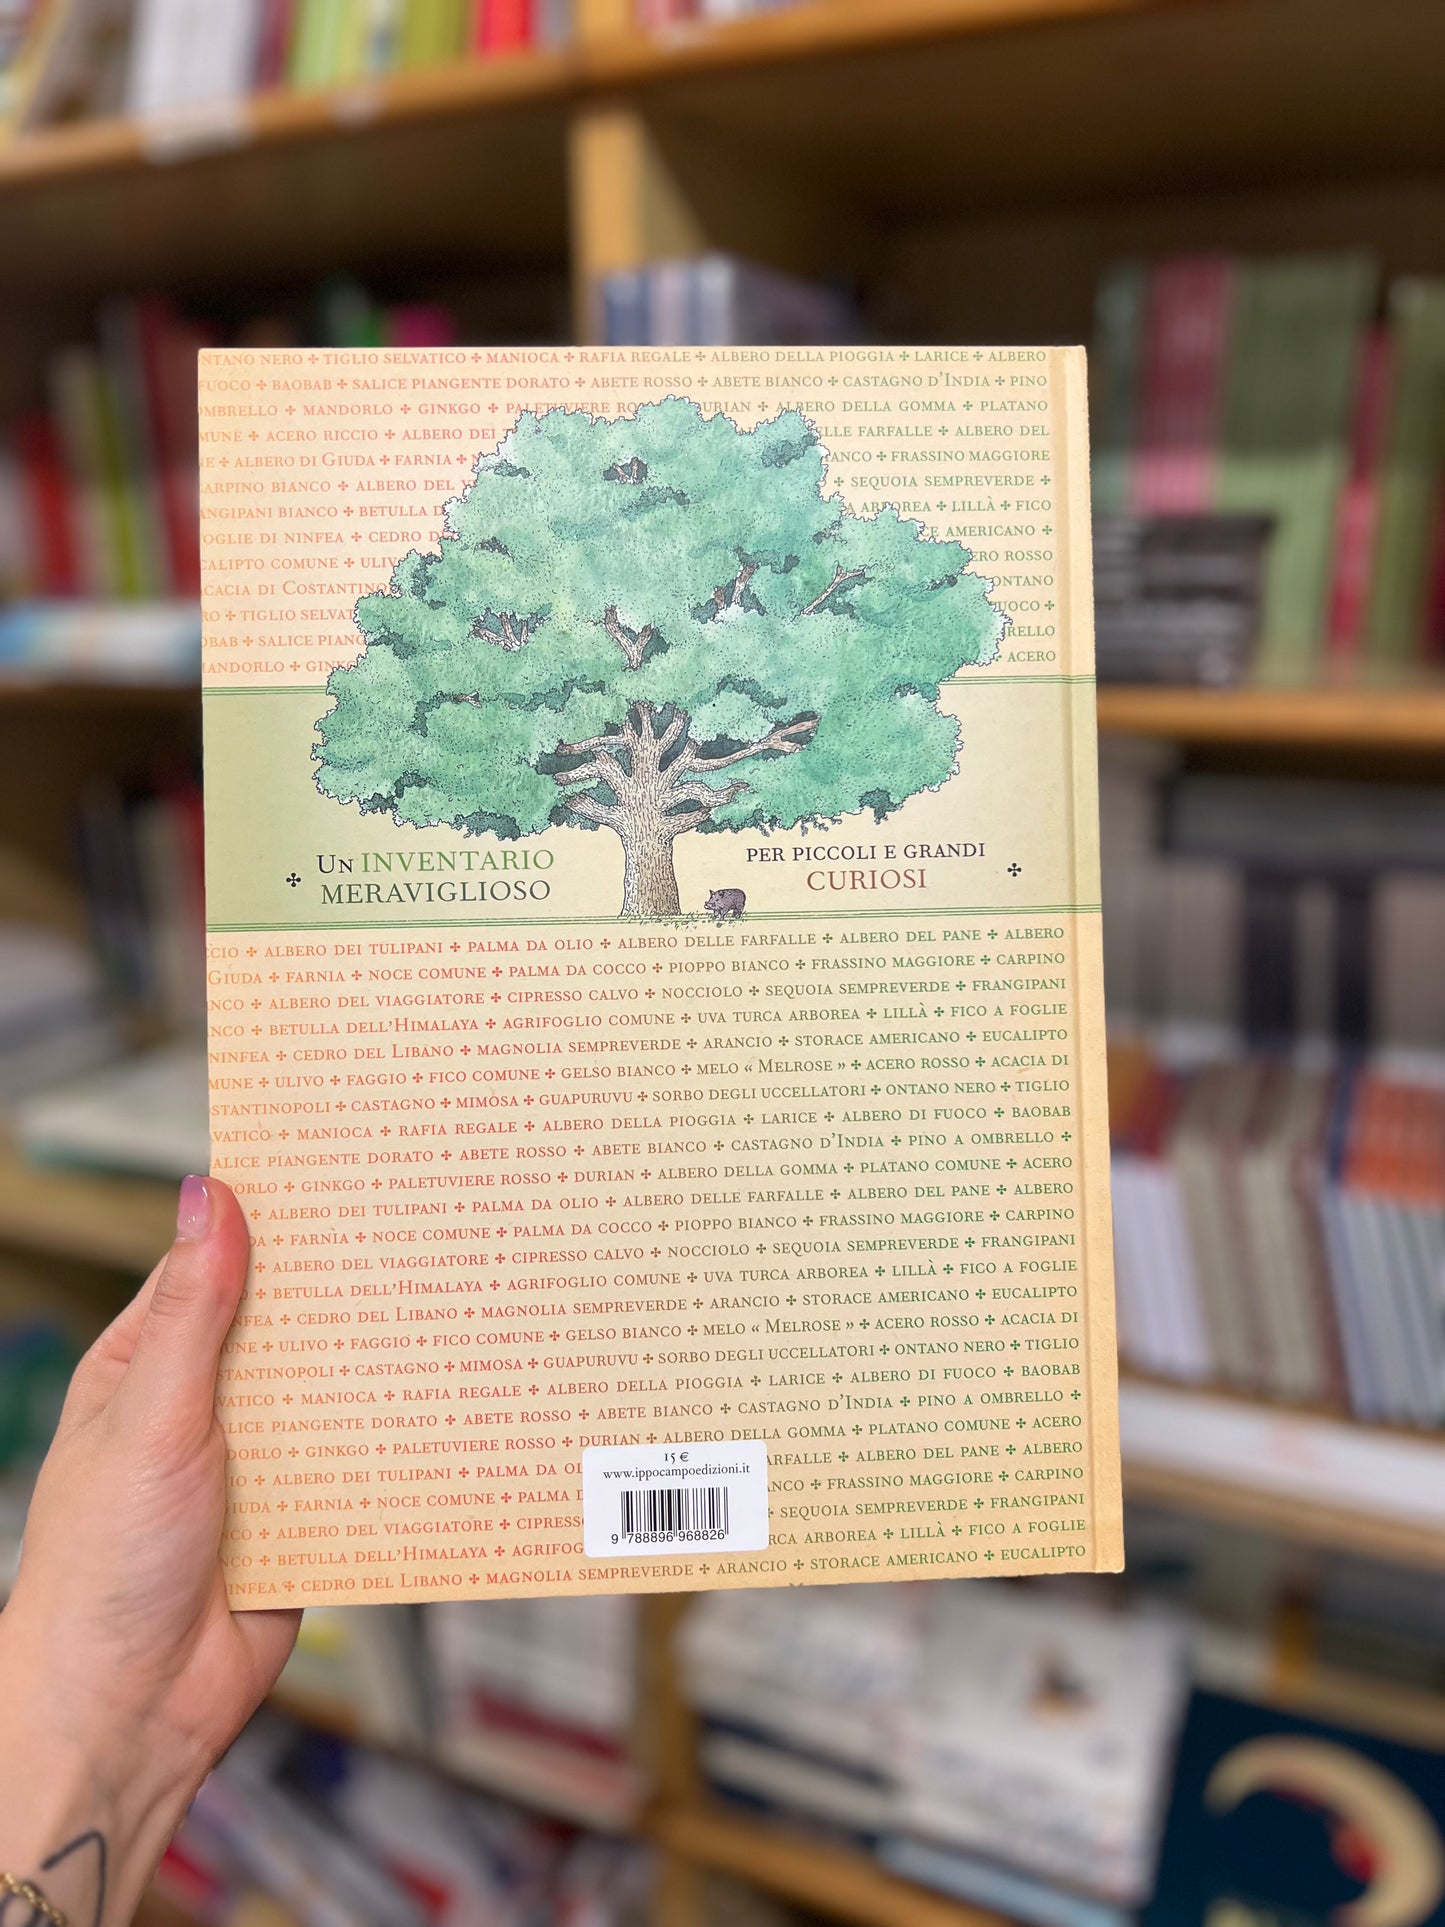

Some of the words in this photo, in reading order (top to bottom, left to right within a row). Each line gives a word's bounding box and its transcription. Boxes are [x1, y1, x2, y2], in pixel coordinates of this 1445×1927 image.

[258, 353, 303, 366] NERO
[322, 352, 379, 365] TIGLIO
[383, 352, 467, 365] SELVATICO
[486, 351, 560, 364] MANIOCA
[579, 351, 627, 363] RAFIA
[631, 351, 692, 363] REGALE
[710, 350, 770, 363] ALBERO
[775, 350, 825, 362] DELLA
[829, 350, 895, 362] PIOGGIA
[914, 350, 969, 362] LARICE
[988, 350, 1047, 362] ALBERO
[272, 379, 332, 391] BAOBAB
[352, 378, 407, 390] SALICE
[411, 377, 502, 390] PIANGENTE
[506, 377, 570, 389] DORATO
[590, 376, 639, 388] ABETE
[643, 376, 693, 388] ROSSO
[712, 376, 761, 388] ABETE
[765, 376, 823, 387] BIANCO
[842, 375, 923, 387] CASTAGNO
[1010, 375, 1047, 387] PINO
[303, 403, 393, 416] MANDORLO
[418, 403, 481, 415] GINKGO
[842, 400, 892, 412] DELLA
[898, 400, 956, 412] GOMMA
[980, 400, 1048, 412] PLATANO
[234, 456, 295, 468] ALBERO
[299, 455, 317, 467] DI
[394, 454, 453, 466] FARNIA
[891, 450, 965, 462] FRASSINO
[968, 449, 1051, 462] MAGGIORE
[271, 480, 331, 493] BIANCO
[355, 480, 417, 492] ALBERO
[423, 479, 455, 491] DEL
[850, 476, 918, 491] SEQUOIA
[924, 475, 1035, 487] SEMPREVERDE
[951, 495, 996, 512] LILLÀ
[1015, 499, 1052, 511] FICO
[259, 532, 277, 544] DI
[284, 532, 344, 544] NINFEA
[368, 530, 422, 543] CEDRO
[945, 525, 1036, 537] AMERICANO
[239, 609, 296, 622] TIGLIO
[1007, 650, 1056, 663] ACERO
[361, 849, 554, 873] INVENTARIO
[746, 848, 785, 862] PER
[792, 845, 876, 861] PICCOLI
[884, 845, 896, 859] E
[904, 843, 985, 858] GRANDI
[807, 868, 927, 891] CURIOSI
[321, 879, 551, 905] MERAVIGLIOSO
[264, 944, 327, 958] ALBERO
[334, 944, 362, 956] DEI
[368, 942, 443, 955] TULIPANI
[468, 940, 520, 953] PALMA
[526, 940, 548, 952] DA
[554, 938, 593, 951] OLIO
[617, 936, 678, 949] ALBERO
[684, 935, 735, 948] DELLE
[740, 933, 817, 946] FARFALLE
[839, 931, 899, 944] ALBERO
[905, 930, 937, 943] DEL
[942, 929, 982, 942] PANE
[1004, 927, 1065, 940] ALBERO
[268, 996, 331, 1010] ALBERO
[337, 996, 370, 1008] DEL
[375, 992, 485, 1007] VIAGGIATORE
[507, 990, 583, 1003] CIPRESSO
[588, 988, 639, 1001] CALVO
[661, 986, 743, 999] NOCCIOLO
[765, 984, 833, 1000] SEQUOIA
[839, 981, 950, 995] SEMPREVERDE
[972, 978, 1066, 991] FRANGIPANI
[209, 1051, 270, 1064] NINFEA
[293, 1048, 347, 1062] CEDRO
[353, 1047, 386, 1060] DEL
[477, 1042, 563, 1056] MAGNOLIA
[568, 1038, 681, 1053] SEMPREVERDE
[703, 1036, 773, 1049] ARANCIO
[794, 1033, 864, 1047] STORACE
[869, 1031, 960, 1045] AMERICANO
[982, 1028, 1068, 1042] EUCALIPTO
[297, 1126, 373, 1140] MANIOCA
[398, 1124, 448, 1137] RAFIA
[455, 1121, 518, 1135] REGALE
[542, 1118, 604, 1132] ALBERO
[611, 1116, 663, 1130] DELLA
[669, 1114, 737, 1128] PIOGGIA
[761, 1111, 817, 1125] LARICE
[842, 1109, 902, 1122] ALBERO
[909, 1109, 927, 1121] DI
[933, 1107, 987, 1120] FUOCO
[1011, 1105, 1071, 1118] BAOBAB
[273, 1286, 344, 1300] BETULLA
[506, 1275, 607, 1291] AGRIFOGLIO
[613, 1272, 681, 1286] COMUNE
[703, 1271, 734, 1283] UVA
[739, 1269, 790, 1282] TURCA
[796, 1266, 869, 1280] ARBOREA
[892, 1260, 937, 1277] LILLÀ
[960, 1262, 997, 1275] FICO
[1003, 1262, 1014, 1274] A
[1019, 1259, 1077, 1273] FOGLIE
[354, 1361, 439, 1376] CASTAGNO
[460, 1358, 523, 1372] MIMOSA
[543, 1354, 638, 1369] GUAPURUVU
[658, 1350, 710, 1364] SORBO
[715, 1349, 763, 1362] DEGLI
[768, 1344, 874, 1360] UCCELLATORI
[894, 1342, 959, 1355] ONTANO
[963, 1340, 1005, 1353] NERO
[1024, 1337, 1079, 1350] TIGLIO
[271, 1417, 365, 1433] PIANGENTE
[371, 1415, 438, 1429] DORATO
[463, 1412, 514, 1426] ABETE
[520, 1409, 571, 1423] ROSSO
[596, 1406, 647, 1420] ABETE
[653, 1403, 713, 1418] BIANCO
[738, 1399, 821, 1414] CASTAGNO
[917, 1394, 956, 1407] PINO
[963, 1394, 974, 1405] A
[980, 1390, 1064, 1404] OMBRELLO
[664, 1452, 676, 1464] 15
[680, 1451, 689, 1462] €
[603, 1462, 750, 1482] www.ippocampoedizioni.it
[294, 1498, 354, 1512] FARNIA
[377, 1495, 421, 1509] NOCE
[426, 1493, 496, 1507] COMUNE
[518, 1490, 570, 1503] PALMA
[827, 1475, 904, 1490] FRASSINO
[909, 1471, 993, 1486] MAGGIORE
[1014, 1467, 1084, 1481] CARPINO
[611, 1533, 619, 1544] 9
[627, 1531, 674, 1544] 788896
[678, 1529, 725, 1542] 968826
[300, 1577, 356, 1592] CEDRO
[362, 1576, 394, 1590] DEL
[486, 1569, 573, 1585] MAGNOLIA
[578, 1564, 694, 1581] SEMPREVERDE
[716, 1560, 787, 1574] ARANCIO
[810, 1555, 880, 1570] STORACE
[886, 1550, 978, 1566] AMERICANO
[1000, 1545, 1086, 1561] EUCALIPTO
